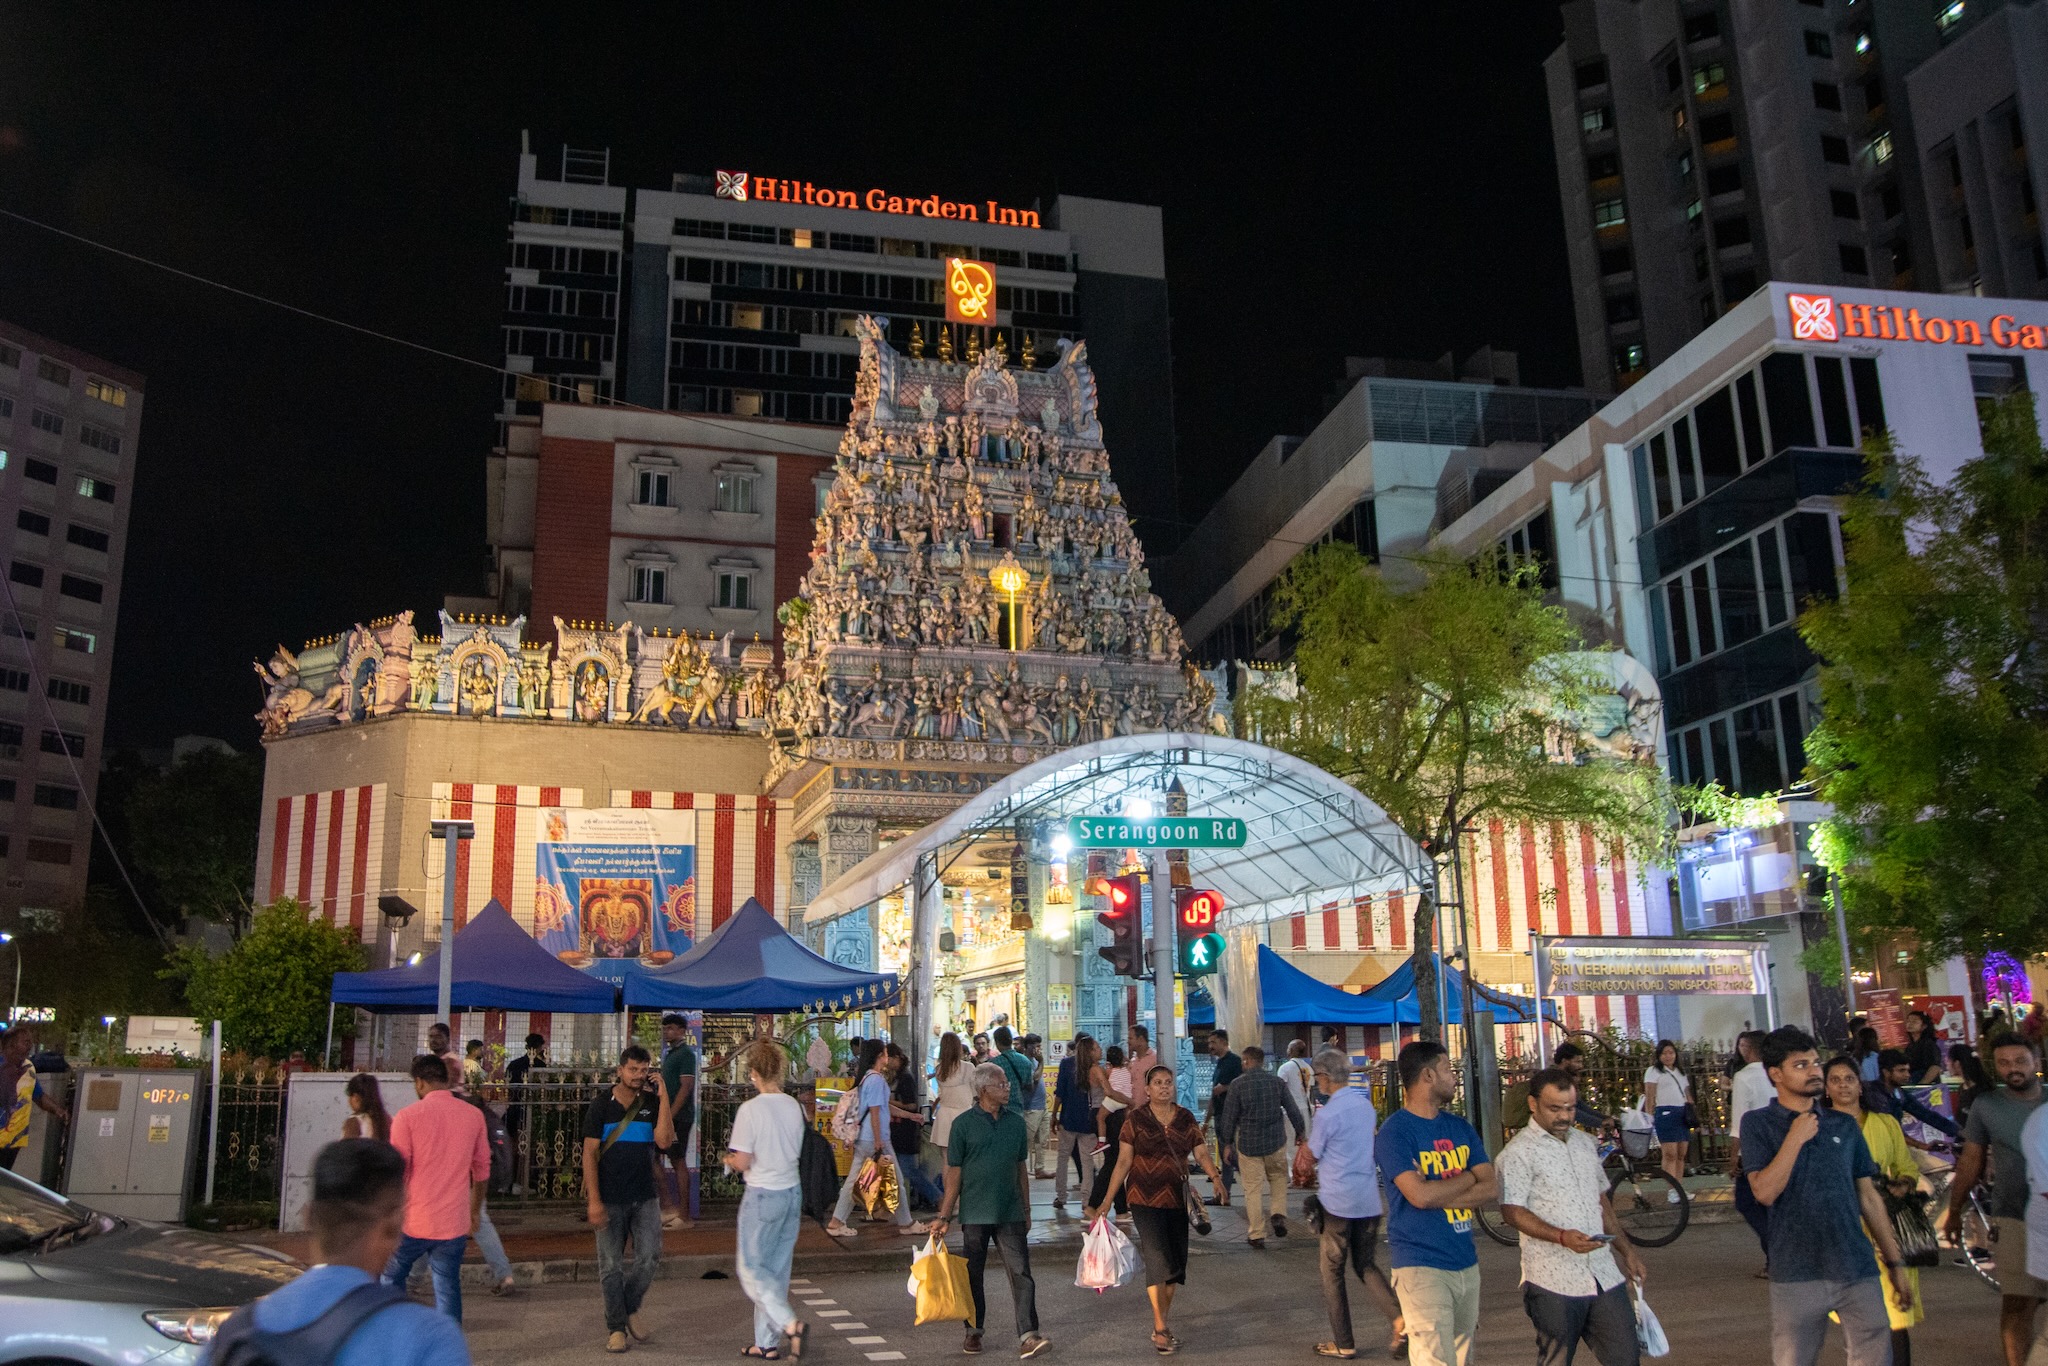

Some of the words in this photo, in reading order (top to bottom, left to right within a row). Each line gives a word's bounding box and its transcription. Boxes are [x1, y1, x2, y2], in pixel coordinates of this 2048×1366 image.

[753, 177, 858, 210] Hilton
[866, 188, 979, 222] Garden
[986, 200, 1042, 228] Inn
[1840, 303, 1984, 346] Hilton
[1990, 314, 2048, 350] Ga
[1079, 819, 1199, 844] Serangoon
[1212, 821, 1237, 840] Rd
[1552, 963, 1573, 976] SRI
[1575, 963, 1706, 976] VEERAMAKALIAMMAN
[1707, 963, 1753, 976] TEMPLE
[1554, 980, 1569, 991] 141
[1572, 979, 1635, 991] SERANGOON
[1637, 980, 1666, 992] ROAD,
[1668, 979, 1722, 991] SINGAPORE
[1419, 1145, 1471, 1176] PROUD
